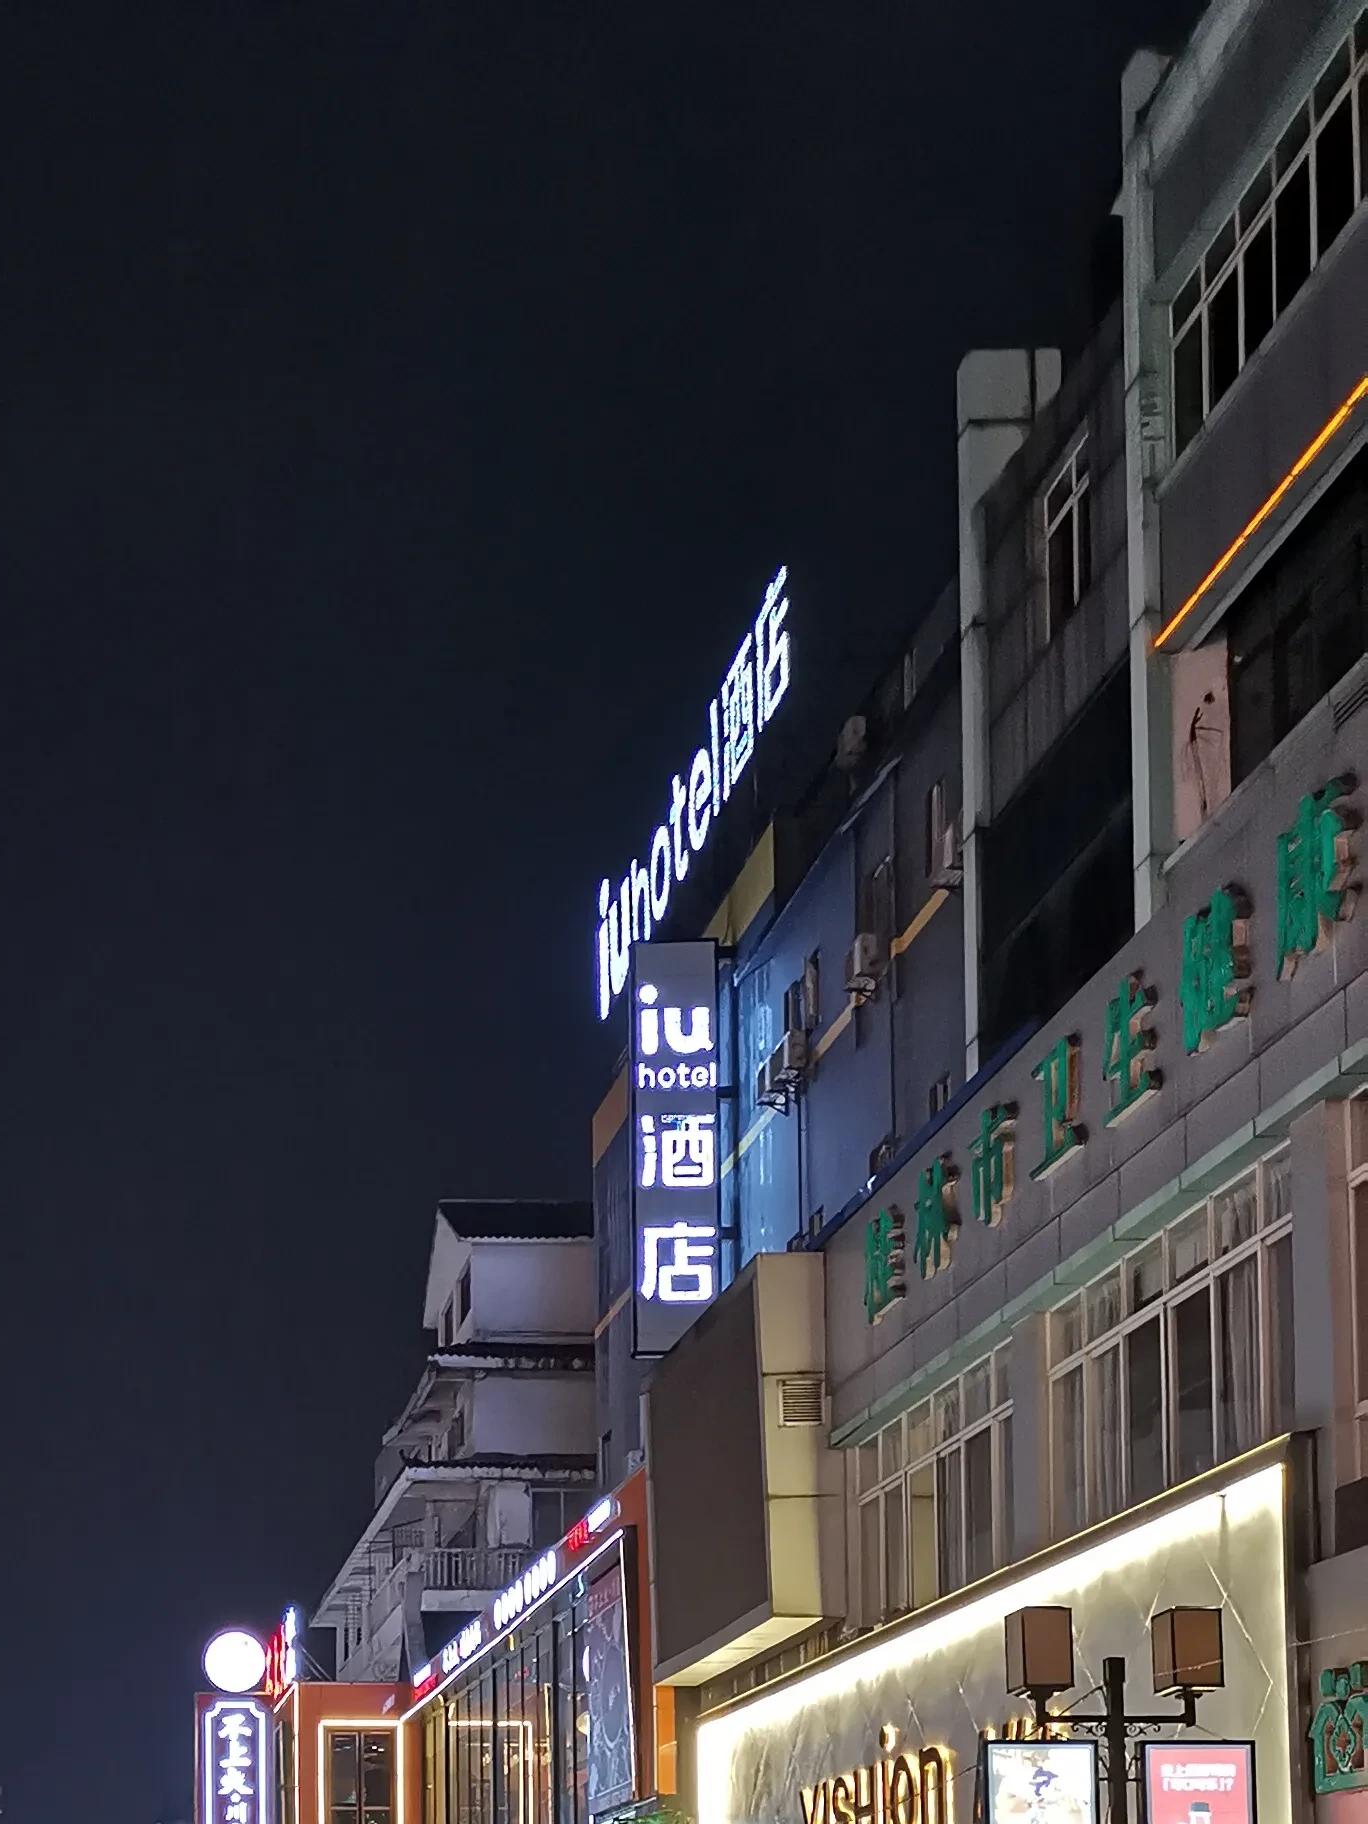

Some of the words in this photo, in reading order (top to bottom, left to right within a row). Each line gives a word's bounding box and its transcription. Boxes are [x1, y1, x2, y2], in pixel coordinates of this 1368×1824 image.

[639, 984, 714, 1056] iu
[638, 1062, 717, 1091] hotel
[641, 1113, 716, 1303] 酒店
